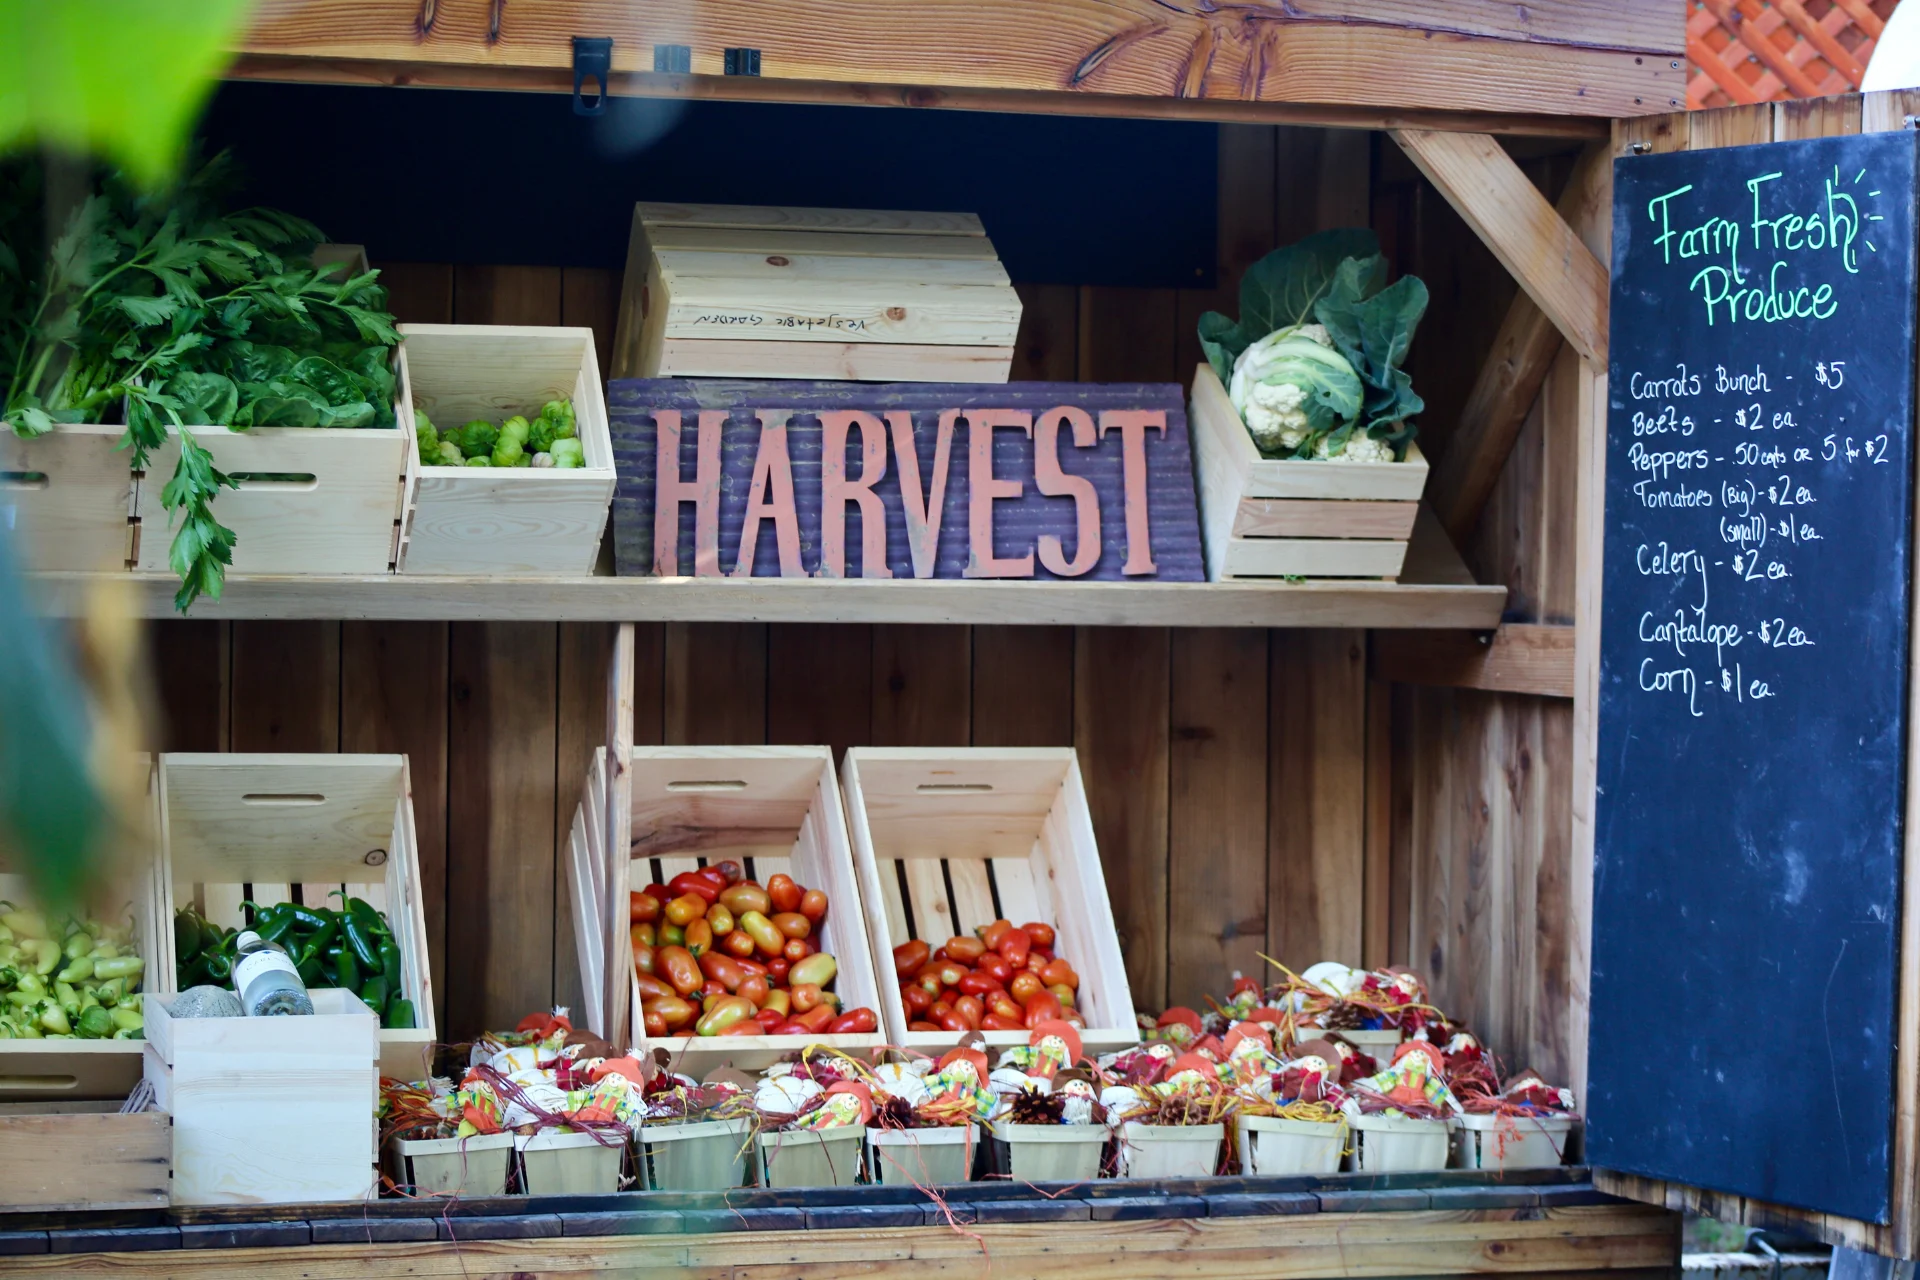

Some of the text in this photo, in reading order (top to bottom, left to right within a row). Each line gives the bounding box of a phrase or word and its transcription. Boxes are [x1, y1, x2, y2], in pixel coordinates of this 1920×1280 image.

[1649, 171, 1859, 285] Farm Fresh
[1690, 260, 1838, 326] Produce
[1630, 363, 1701, 400] Carrots
[1715, 364, 1771, 394] Bunch
[1815, 361, 1845, 389] $5
[1631, 405, 1695, 436] Beets
[1735, 403, 1763, 430] $2
[1772, 411, 1798, 430] ea.
[1628, 442, 1709, 482] Peppers
[1821, 434, 1837, 461] 5
[1845, 437, 1860, 463] for
[1865, 434, 1889, 464] $2
[651, 405, 1167, 578] HARVEST
[1633, 479, 1712, 508] Tomatoes
[1768, 475, 1794, 506] $2
[1778, 513, 1796, 543] $1
[1636, 541, 1708, 613] Celery
[1732, 549, 1764, 582] $2
[1767, 561, 1793, 579] ea.
[1639, 608, 1743, 668] Cantalope
[1758, 618, 1787, 648] $2
[1639, 657, 1704, 717] Corn
[1720, 662, 1742, 703] $1
[1749, 680, 1776, 699] ea.
